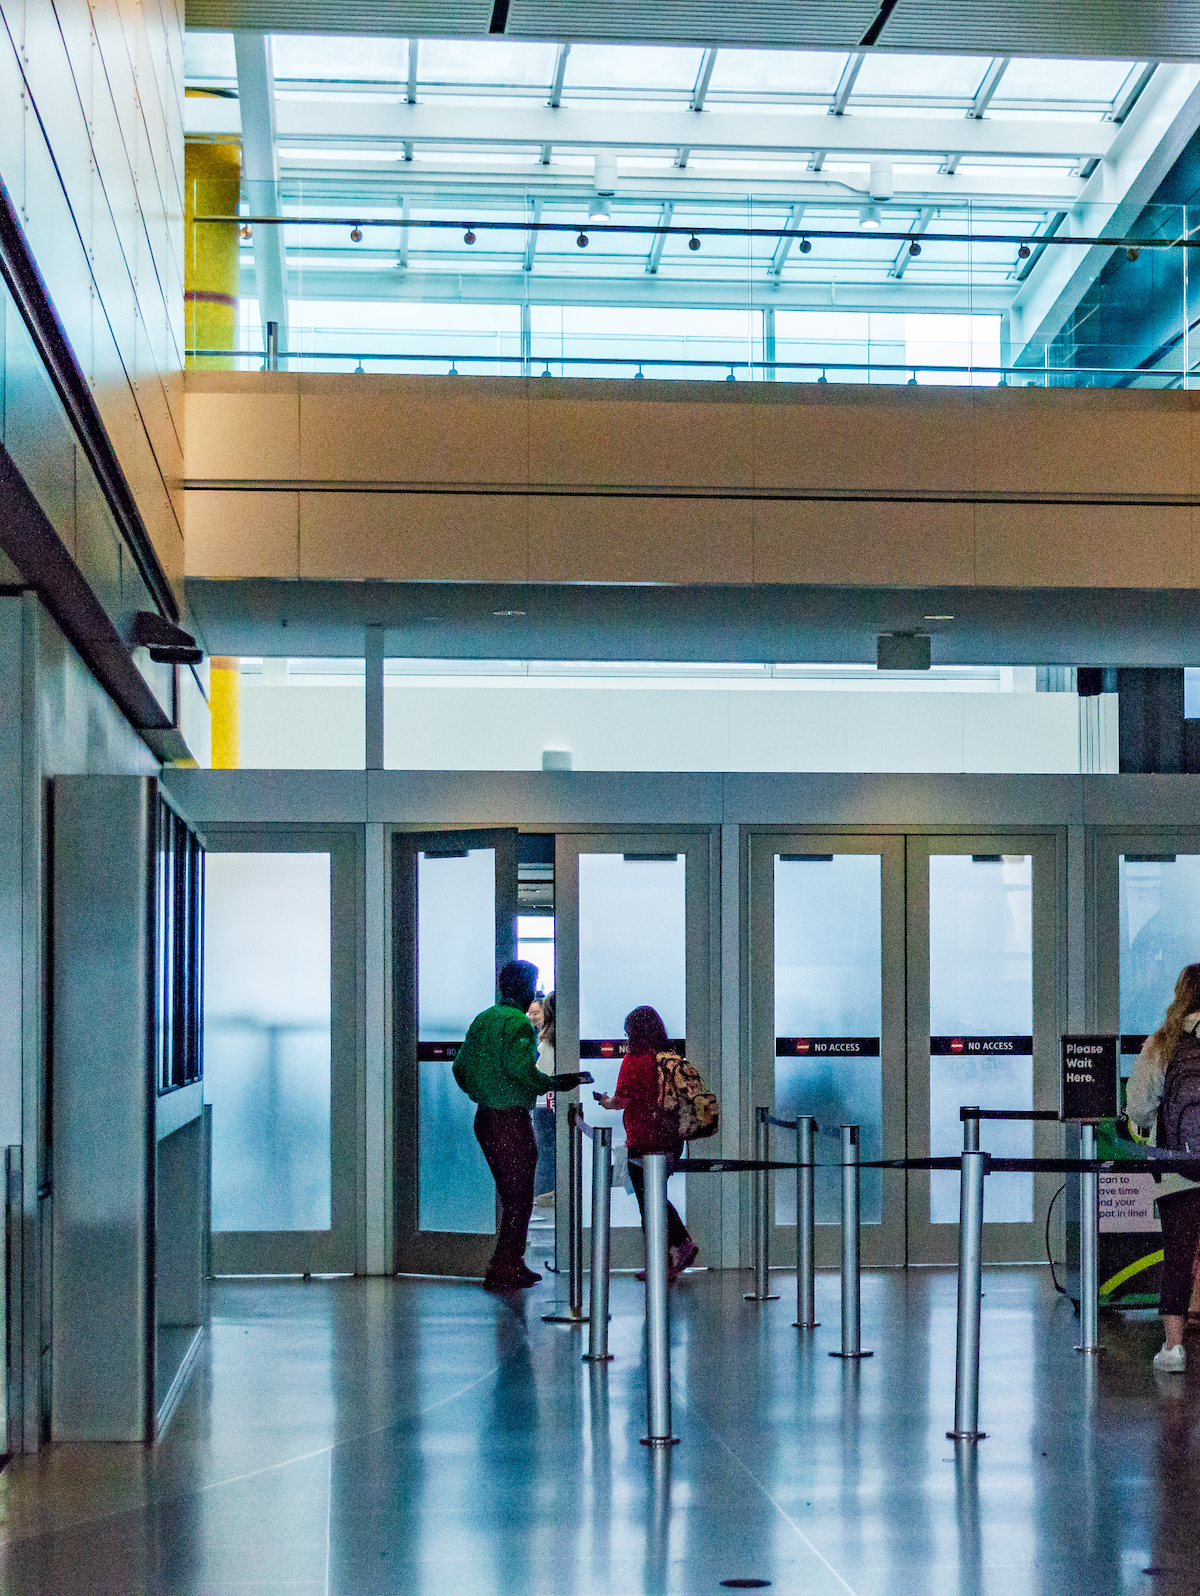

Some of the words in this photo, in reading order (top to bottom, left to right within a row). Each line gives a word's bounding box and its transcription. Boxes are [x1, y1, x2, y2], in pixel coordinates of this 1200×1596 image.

[814, 1043, 828, 1052] NO
[829, 1043, 860, 1053] ACCESS
[968, 1042, 980, 1051] NO
[982, 1041, 1013, 1051] ACCESS
[1066, 1044, 1103, 1054] Please
[1066, 1058, 1092, 1069] Wait
[1066, 1073, 1095, 1083] Here.
[1120, 1176, 1130, 1184] to
[1119, 1187, 1139, 1195] time
[1115, 1200, 1136, 1208] your
[1099, 1210, 1115, 1218] pot
[1127, 1209, 1147, 1217] line!
